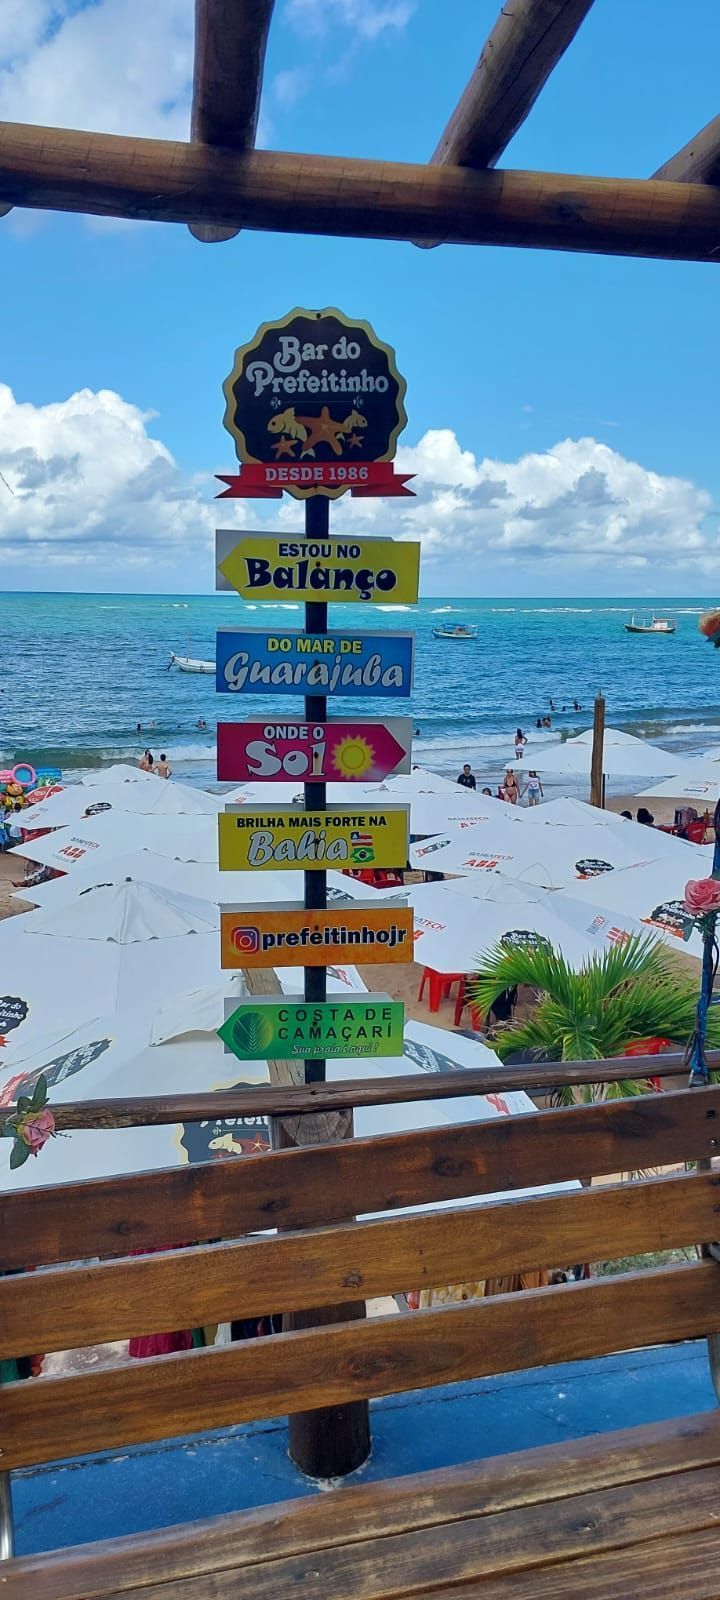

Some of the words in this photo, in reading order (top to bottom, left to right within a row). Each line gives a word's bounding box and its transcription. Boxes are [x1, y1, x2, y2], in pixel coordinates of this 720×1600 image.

[273, 336, 328, 372] Bar
[332, 336, 361, 360] do
[245, 361, 389, 397] Prefeitinho
[265, 467, 323, 481] DESDE
[329, 467, 368, 480] 1986
[278, 543, 332, 559] ESTOU
[336, 544, 361, 559] NO
[243, 557, 397, 600] Balanço
[267, 637, 292, 653] DO
[296, 638, 334, 653] MAR
[340, 639, 362, 654] DE
[223, 652, 404, 692] Guarajuba
[264, 725, 309, 740] ONDE
[313, 726, 324, 740] O
[244, 740, 327, 777] Sol
[236, 817, 285, 828] BRILHA
[288, 816, 322, 827] MAIS
[325, 816, 366, 827] FORTE
[369, 815, 387, 826] NA
[247, 830, 349, 866] Bahia
[462, 858, 499, 868] ABB
[262, 926, 406, 952] prefeitinhojr
[10, 1002, 22, 1010] do
[278, 1008, 355, 1022] COSTA
[365, 1008, 392, 1020] DE
[278, 1023, 392, 1041] CAMAÇARÍ
[291, 1044, 311, 1055] Sua
[313, 1043, 341, 1056] praia
